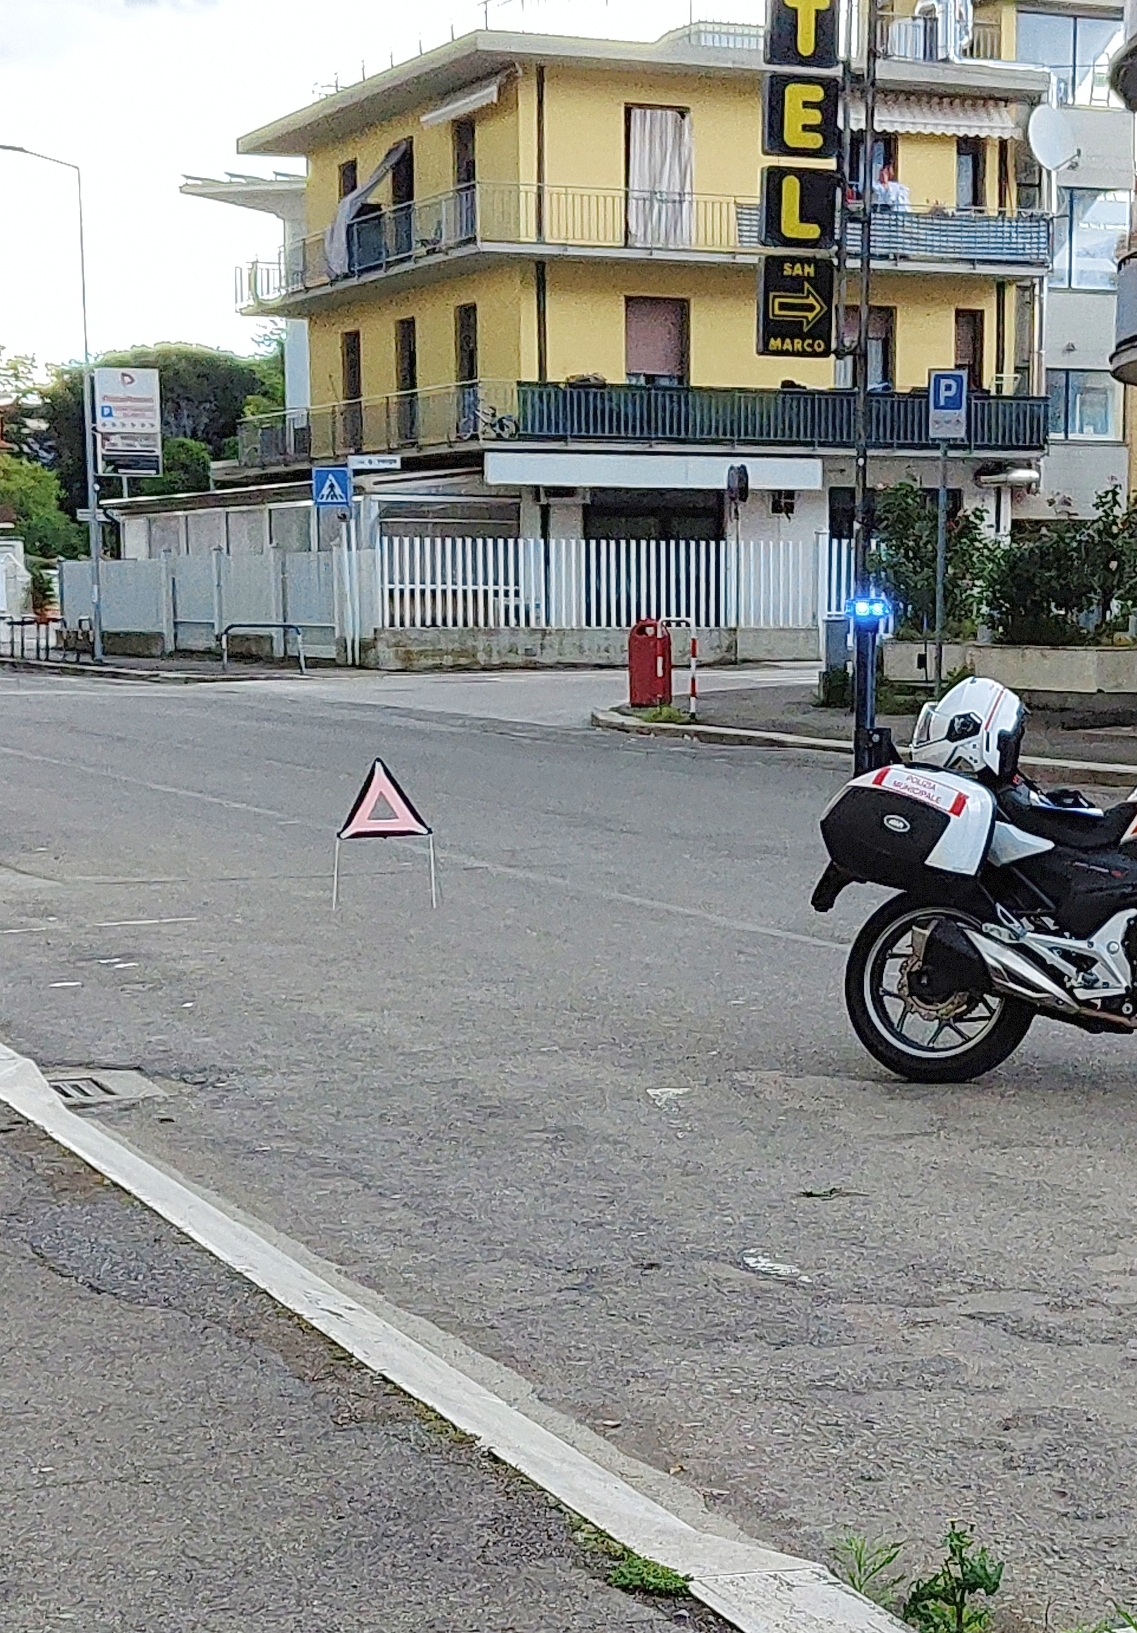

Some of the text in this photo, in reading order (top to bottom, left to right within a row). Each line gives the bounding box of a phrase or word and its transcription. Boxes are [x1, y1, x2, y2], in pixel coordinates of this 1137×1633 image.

[783, 262, 815, 277] SAN
[768, 337, 826, 353] MARCO
[940, 378, 957, 406] P
[893, 780, 943, 804] MUNICIPALE
[906, 775, 937, 792] POLIZIA
